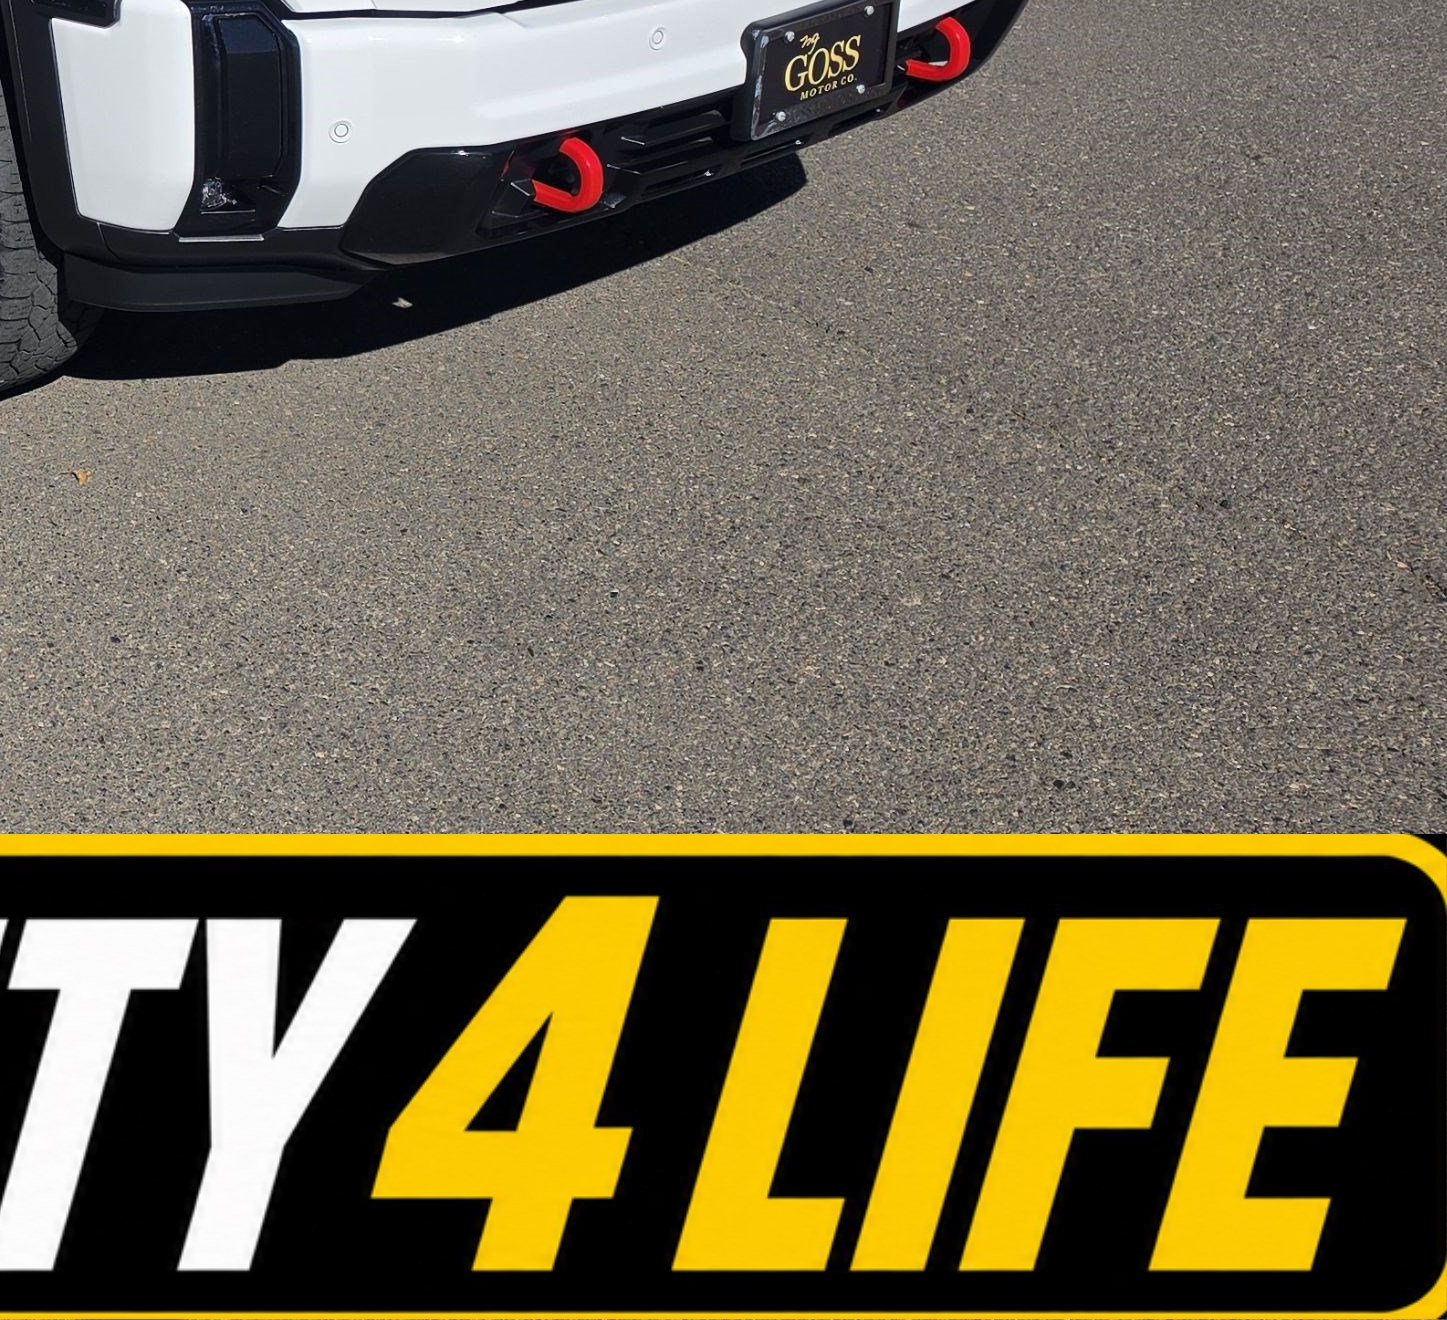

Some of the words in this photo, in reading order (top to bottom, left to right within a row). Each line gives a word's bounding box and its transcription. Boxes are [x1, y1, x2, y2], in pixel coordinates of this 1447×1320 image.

[784, 34, 862, 92] GOSS
[799, 80, 838, 101] MOTOR
[840, 73, 858, 86] CO.
